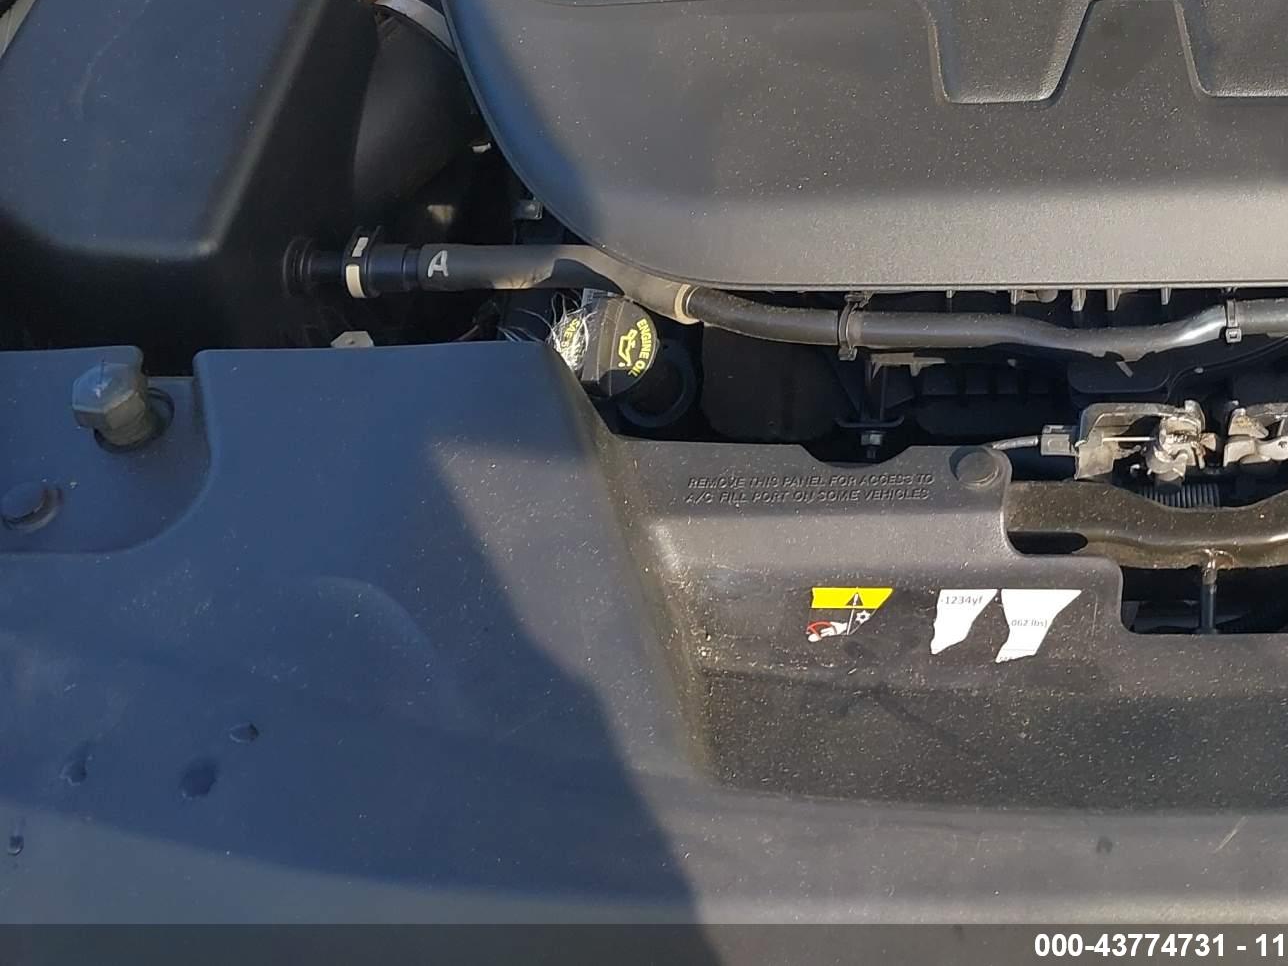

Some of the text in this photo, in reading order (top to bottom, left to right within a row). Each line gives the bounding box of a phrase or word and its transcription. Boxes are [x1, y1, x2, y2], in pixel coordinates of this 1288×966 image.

[427, 249, 449, 277] A
[628, 318, 652, 377] ENGINE OIL
[687, 473, 935, 490] REMOVE THIS PANEL FOR ACCESS TO
[685, 488, 930, 504] A/C FILL PORT ON SOME VEHICLES
